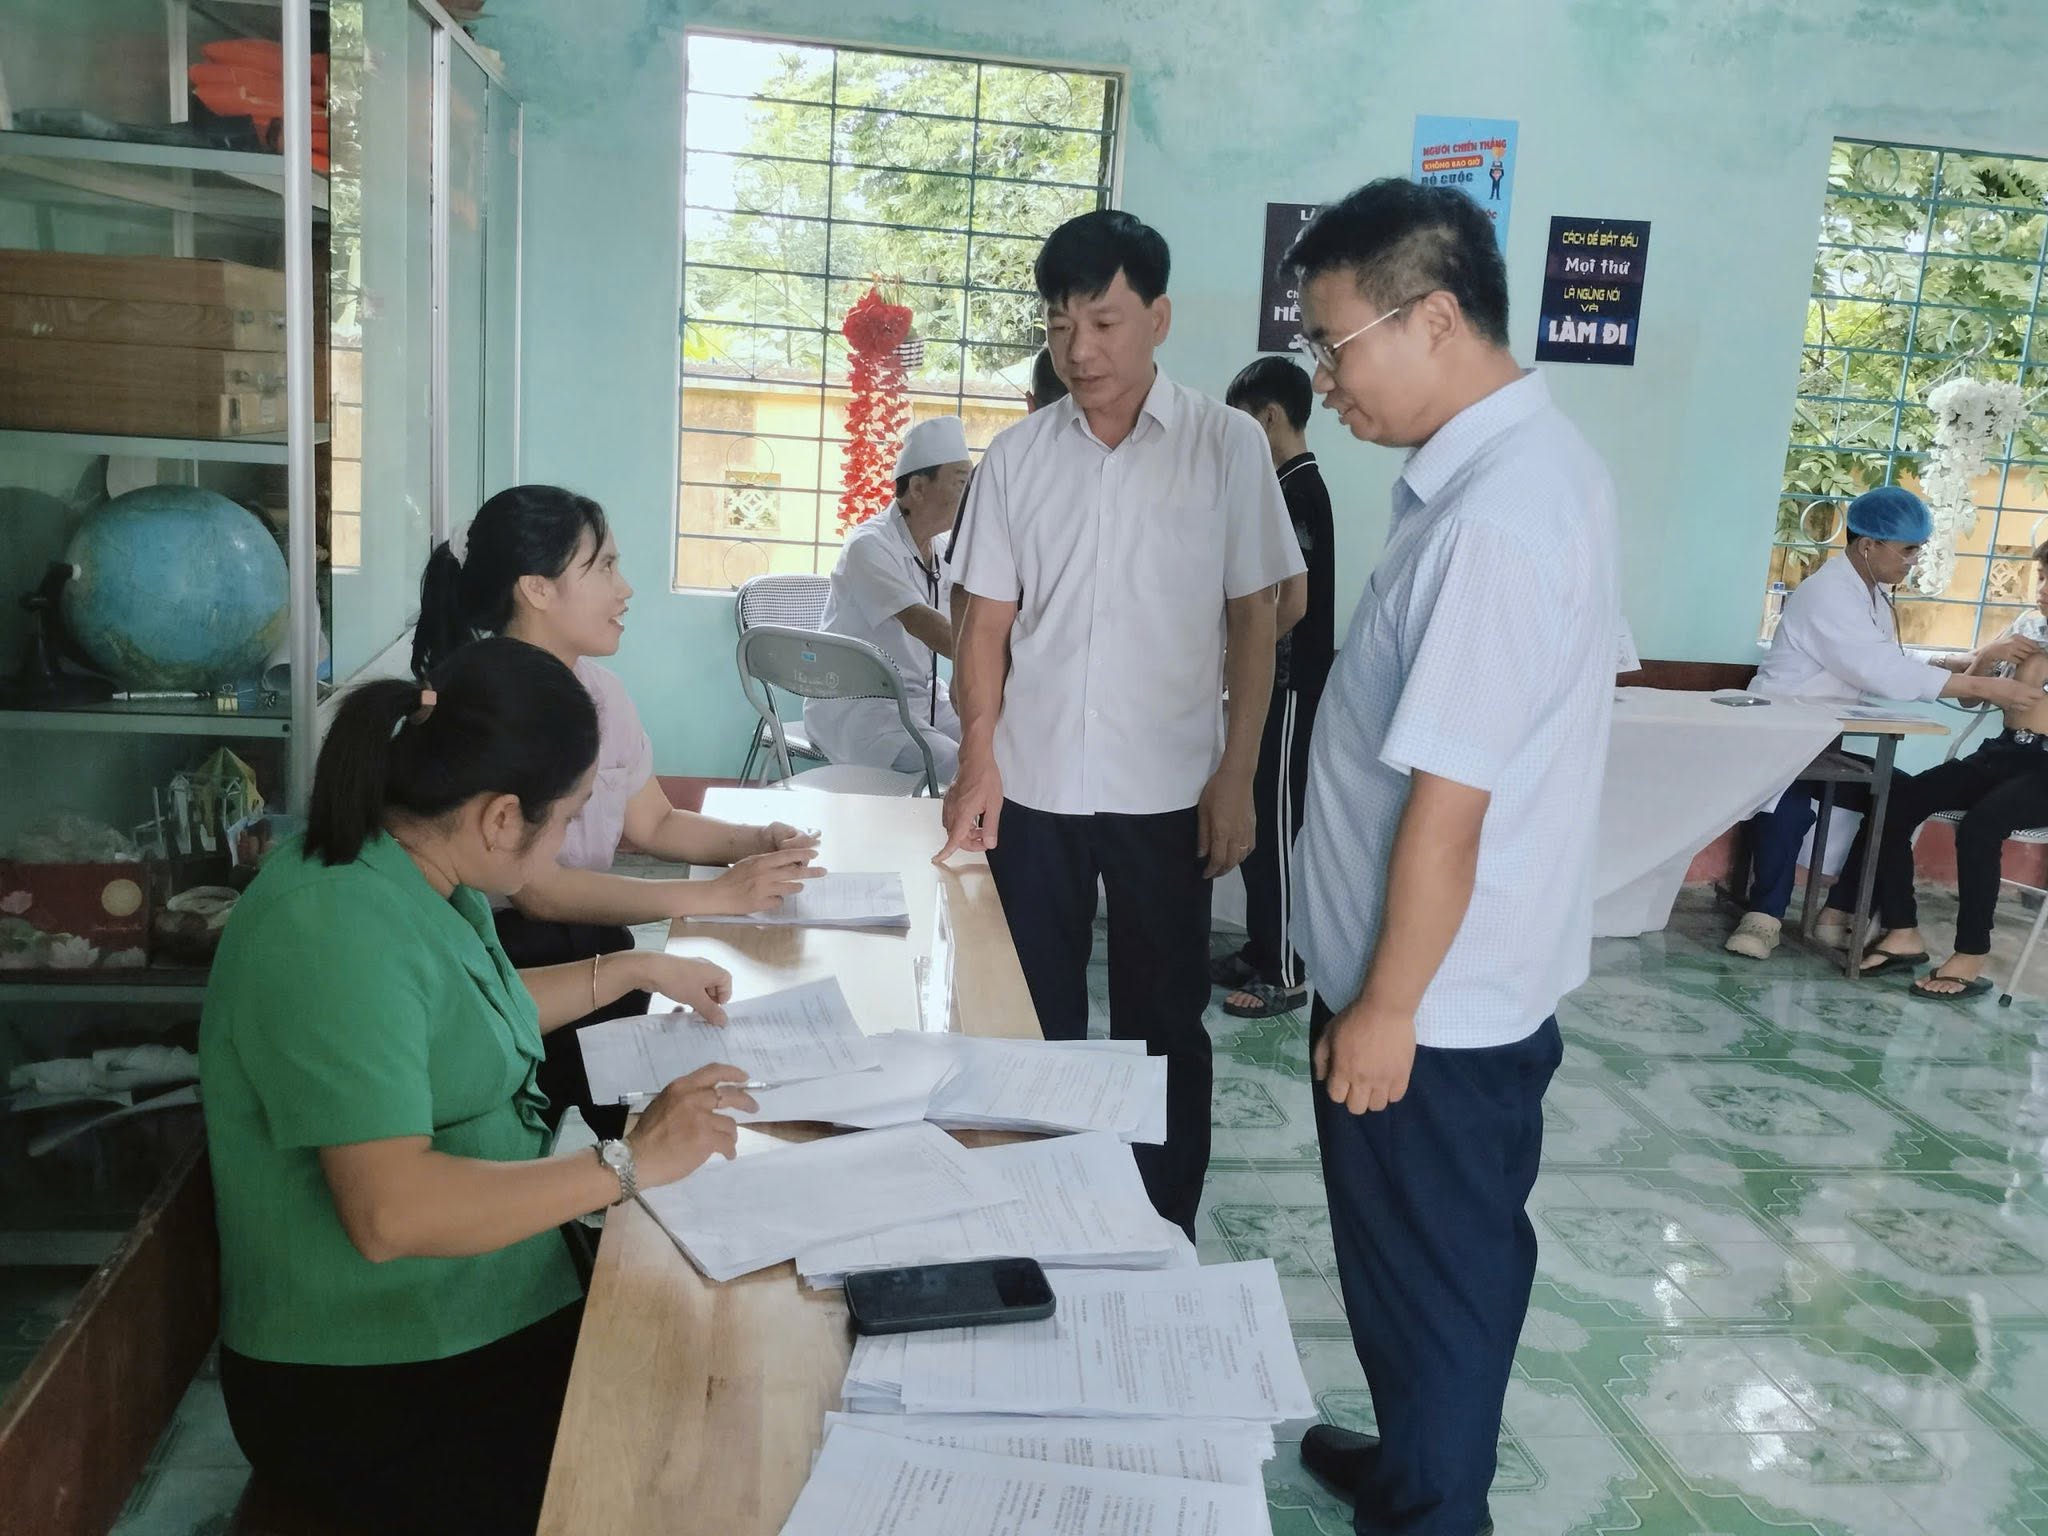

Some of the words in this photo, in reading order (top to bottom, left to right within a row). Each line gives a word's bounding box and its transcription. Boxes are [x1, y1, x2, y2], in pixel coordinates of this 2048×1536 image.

[1424, 160, 1450, 170] KHÔNG
[1452, 160, 1466, 168] BAO
[1467, 158, 1481, 166] GIỜ
[1562, 229, 1585, 245] CÁCH
[1564, 256, 1596, 275] Mọi
[1600, 259, 1631, 275] thứ
[1548, 315, 1598, 344] LÀM
[1602, 323, 1628, 346] ĐI
